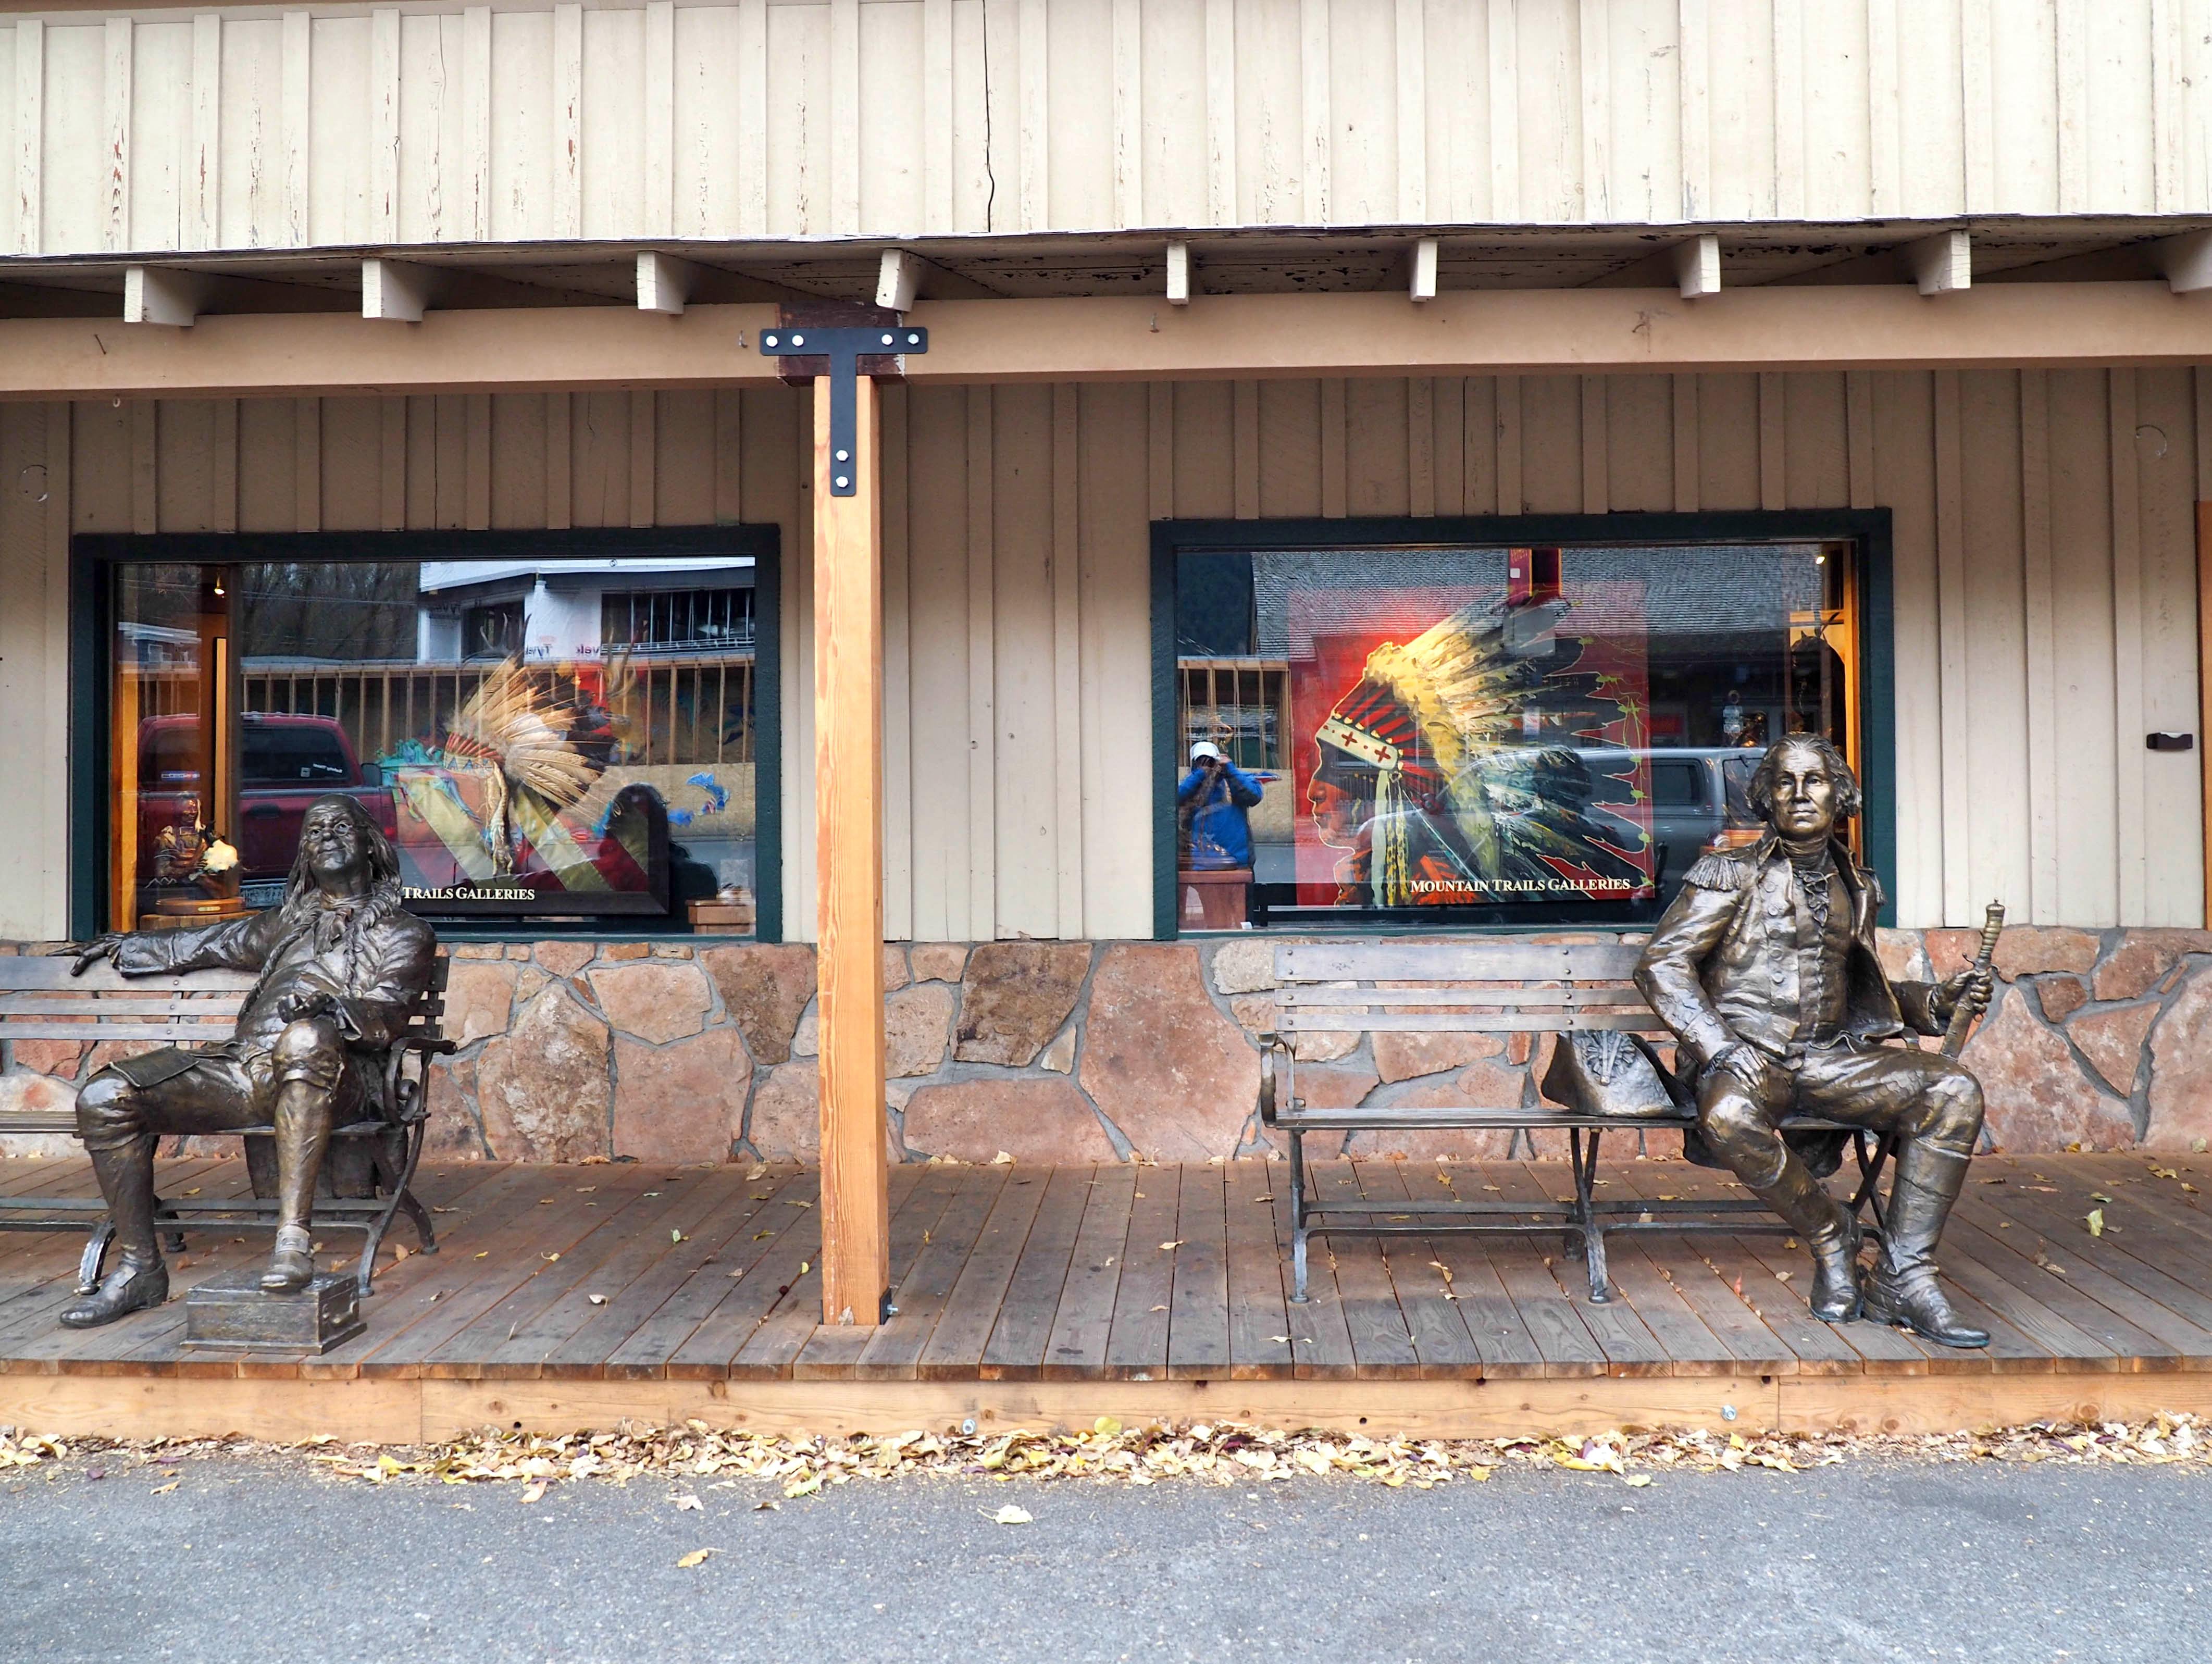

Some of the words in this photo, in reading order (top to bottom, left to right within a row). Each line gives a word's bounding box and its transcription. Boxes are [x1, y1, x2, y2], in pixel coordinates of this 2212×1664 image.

[1410, 880, 1488, 892] MOUNTAIN
[1492, 879, 1545, 891] TRAILS
[1548, 878, 1630, 890] GALLERIES
[403, 887, 453, 899] TRAILS
[455, 887, 535, 900] GALLERIES
